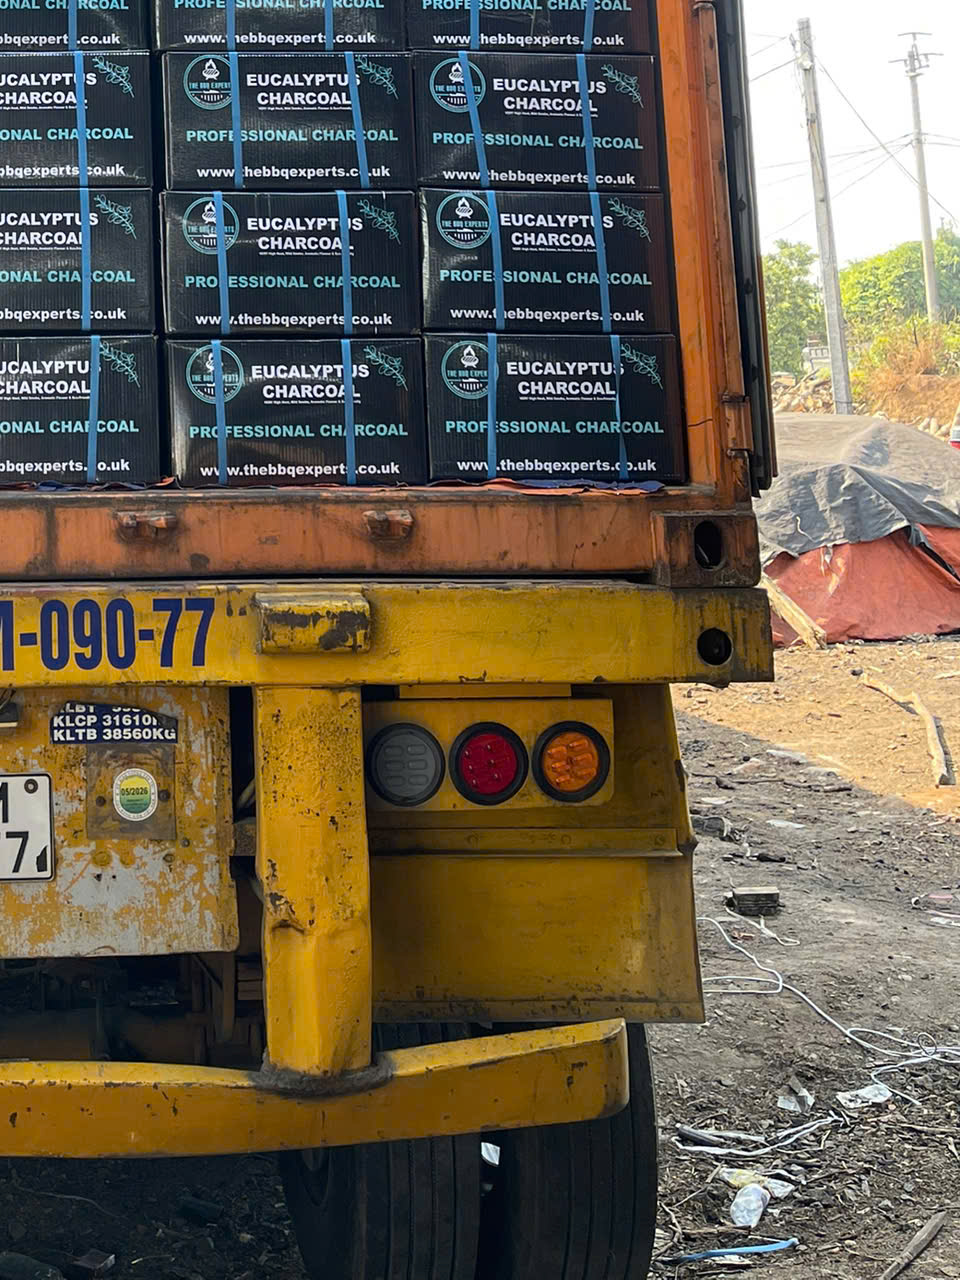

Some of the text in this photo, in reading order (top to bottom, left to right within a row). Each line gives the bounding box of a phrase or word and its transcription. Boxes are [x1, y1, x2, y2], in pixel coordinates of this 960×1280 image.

[256, 91, 352, 105] CHARCOAL
[311, 129, 398, 141] CHAROAL
[432, 132, 553, 146] PROFSSIONAL
[246, 217, 363, 231] EUCALYPTS
[499, 212, 614, 228] EUCALYPTS
[257, 236, 354, 250] CHARCOA
[510, 231, 606, 247] CHARCOA
[47, 270, 135, 282] CHACOAL
[184, 275, 308, 288] PROESSIONAL
[439, 269, 652, 285] PROFESIONAL CHACOAL
[517, 380, 616, 395] CHARCOAL
[319, 423, 408, 436] CHRCOAL
[445, 420, 571, 433] PROFSSIONAL
[53, 715, 98, 727] KLCP
[53, 728, 177, 741] KLTB 38560KG
[121, 786, 149, 797] 05/2026
